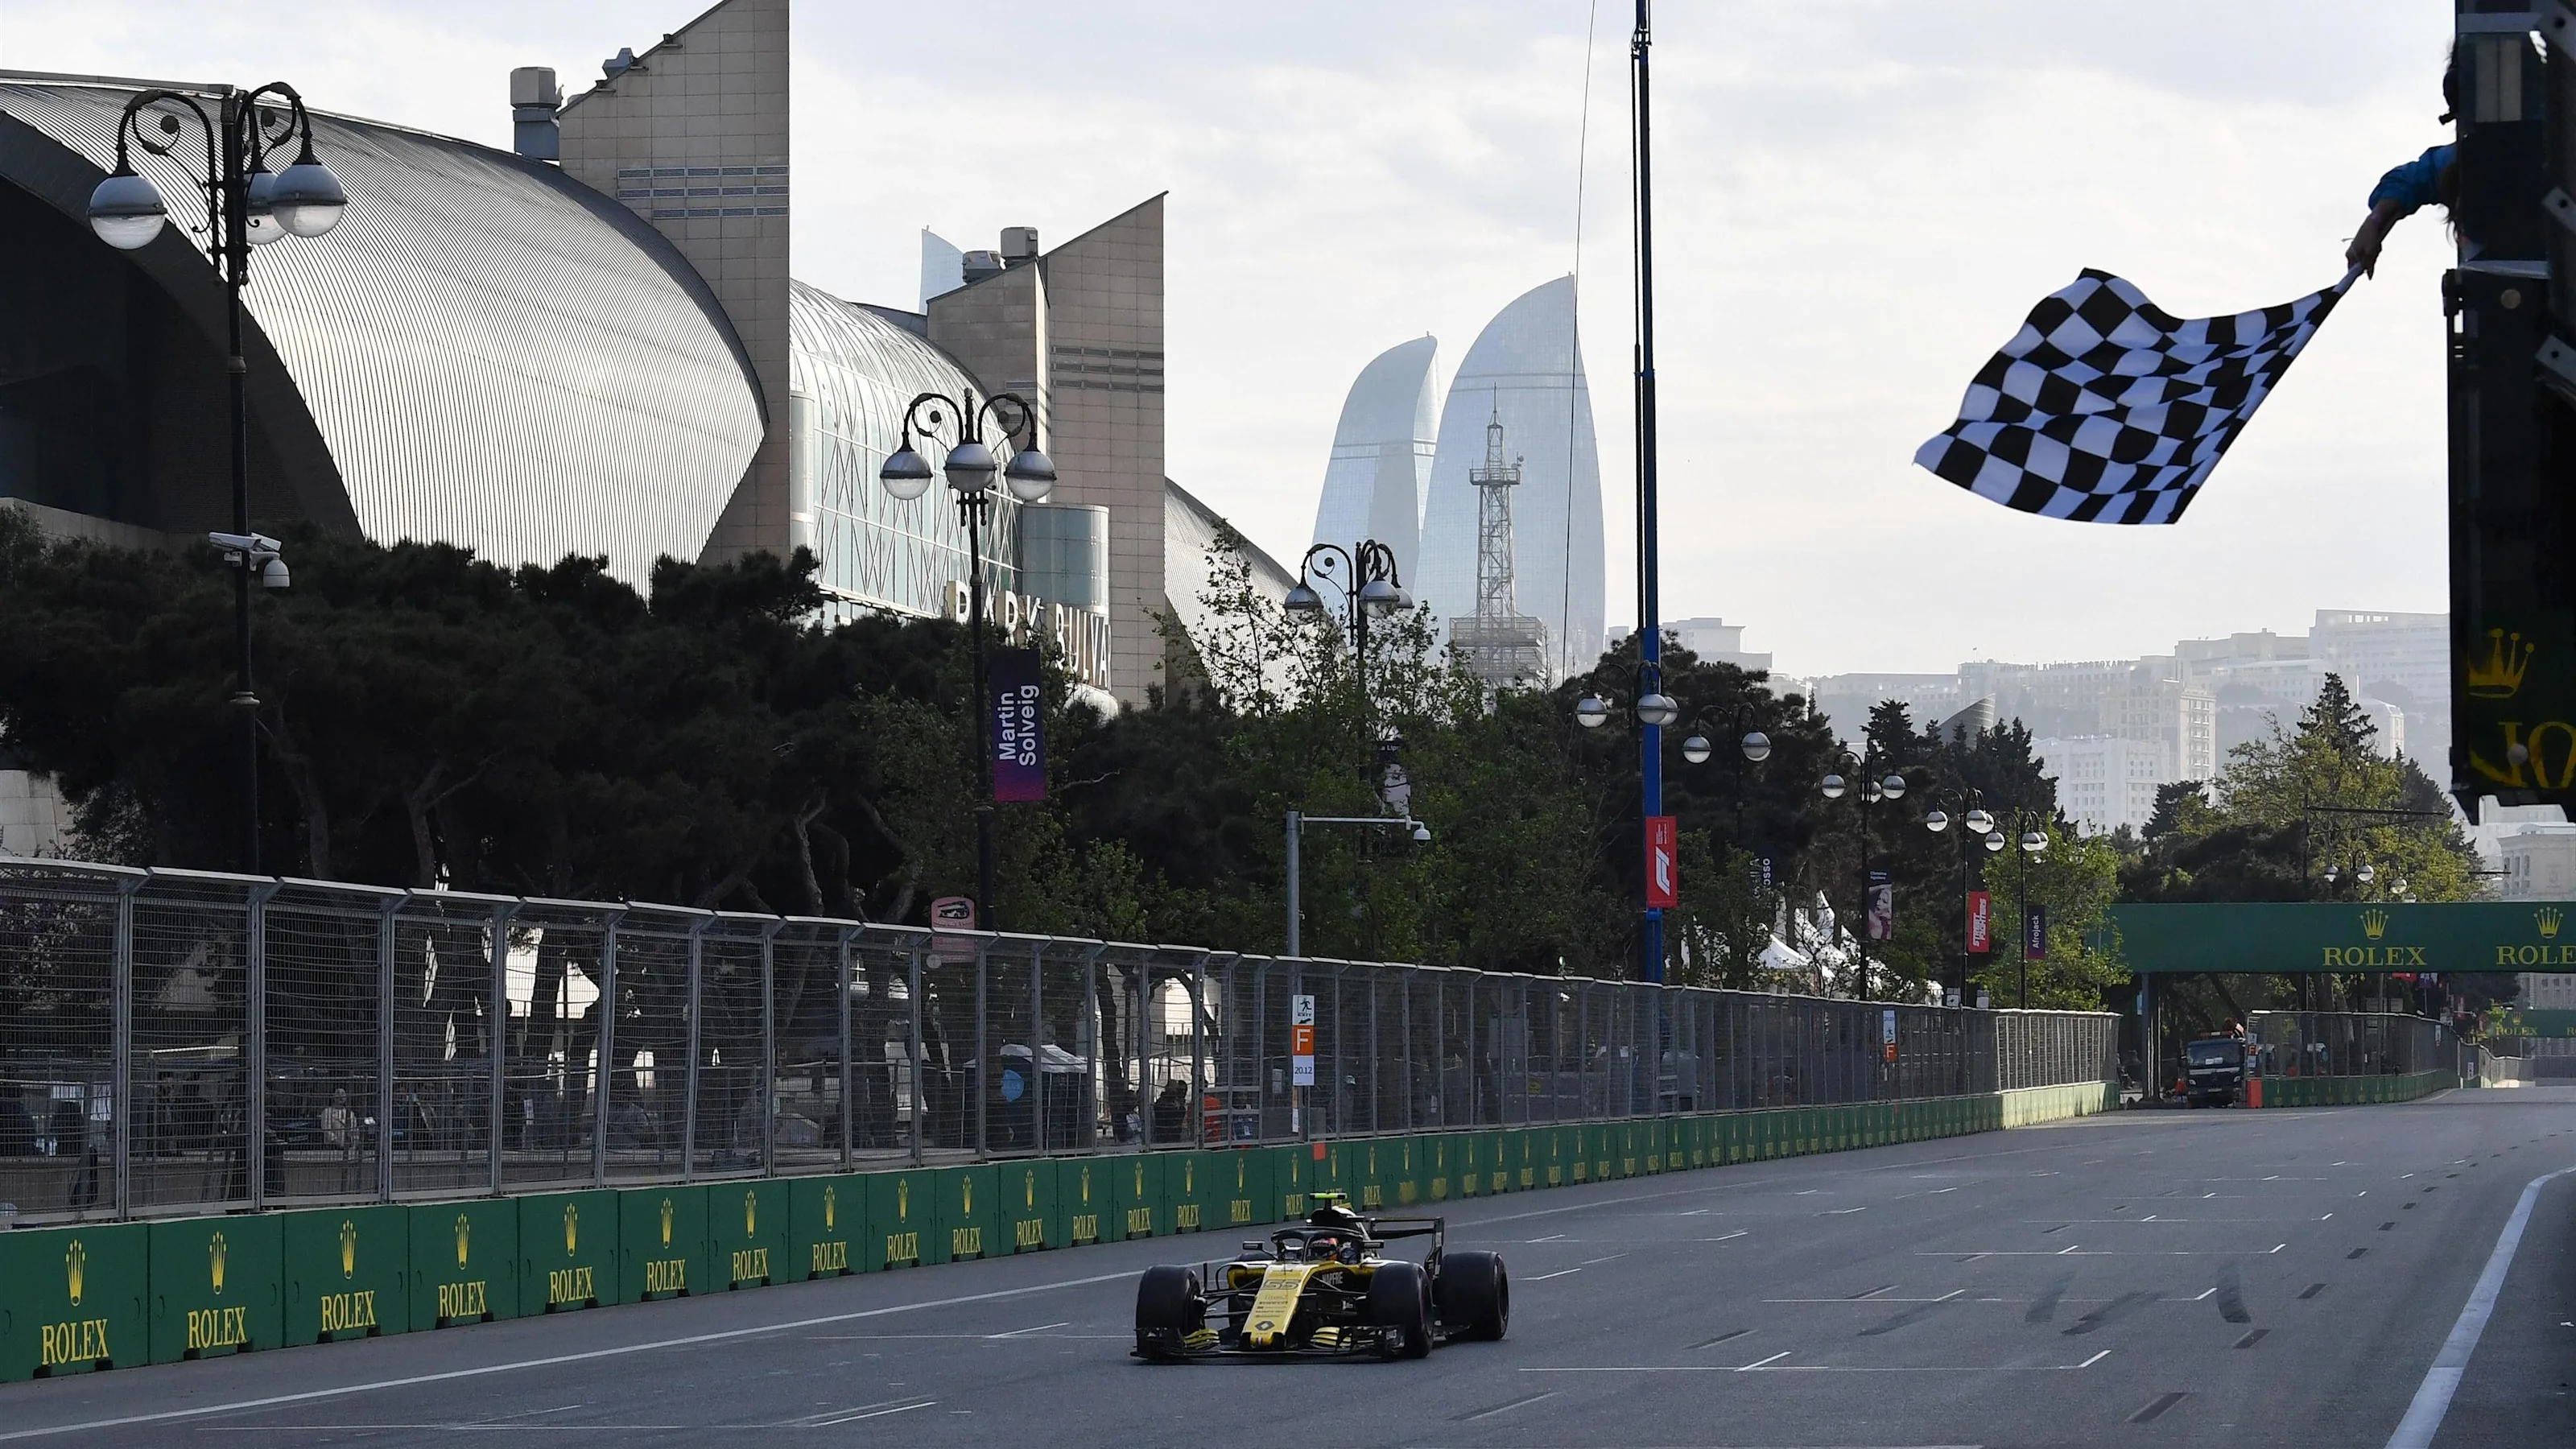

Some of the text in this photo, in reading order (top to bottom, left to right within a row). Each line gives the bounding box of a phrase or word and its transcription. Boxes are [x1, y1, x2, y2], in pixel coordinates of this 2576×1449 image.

[997, 692, 1016, 760] Martin
[1018, 685, 1040, 766] Solveig
[2032, 914, 2041, 948] Afrojack
[2322, 947, 2426, 966] ROLEX
[1297, 1029, 1311, 1051] F
[2496, 1026, 2538, 1036] ROLEX
[1128, 1208, 1150, 1232] ROLEX
[1177, 1204, 1200, 1228] ROLEX
[1231, 1199, 1251, 1222] ROLEX
[1286, 1194, 1304, 1216] ROLEX
[953, 1227, 981, 1254] ROLEX
[1016, 1219, 1045, 1246] ROLEX
[1073, 1215, 1097, 1240] ROLEX
[812, 1241, 848, 1272] ROLEX
[886, 1232, 919, 1262] ROLEX
[646, 1259, 686, 1293] ROLEX
[732, 1248, 770, 1282] ROLEX
[549, 1266, 595, 1303] ROLEX
[321, 1290, 377, 1332] ROLEX
[438, 1281, 488, 1319] ROLEX
[42, 1319, 109, 1365] ROLEX
[188, 1307, 247, 1349] ROLEX
